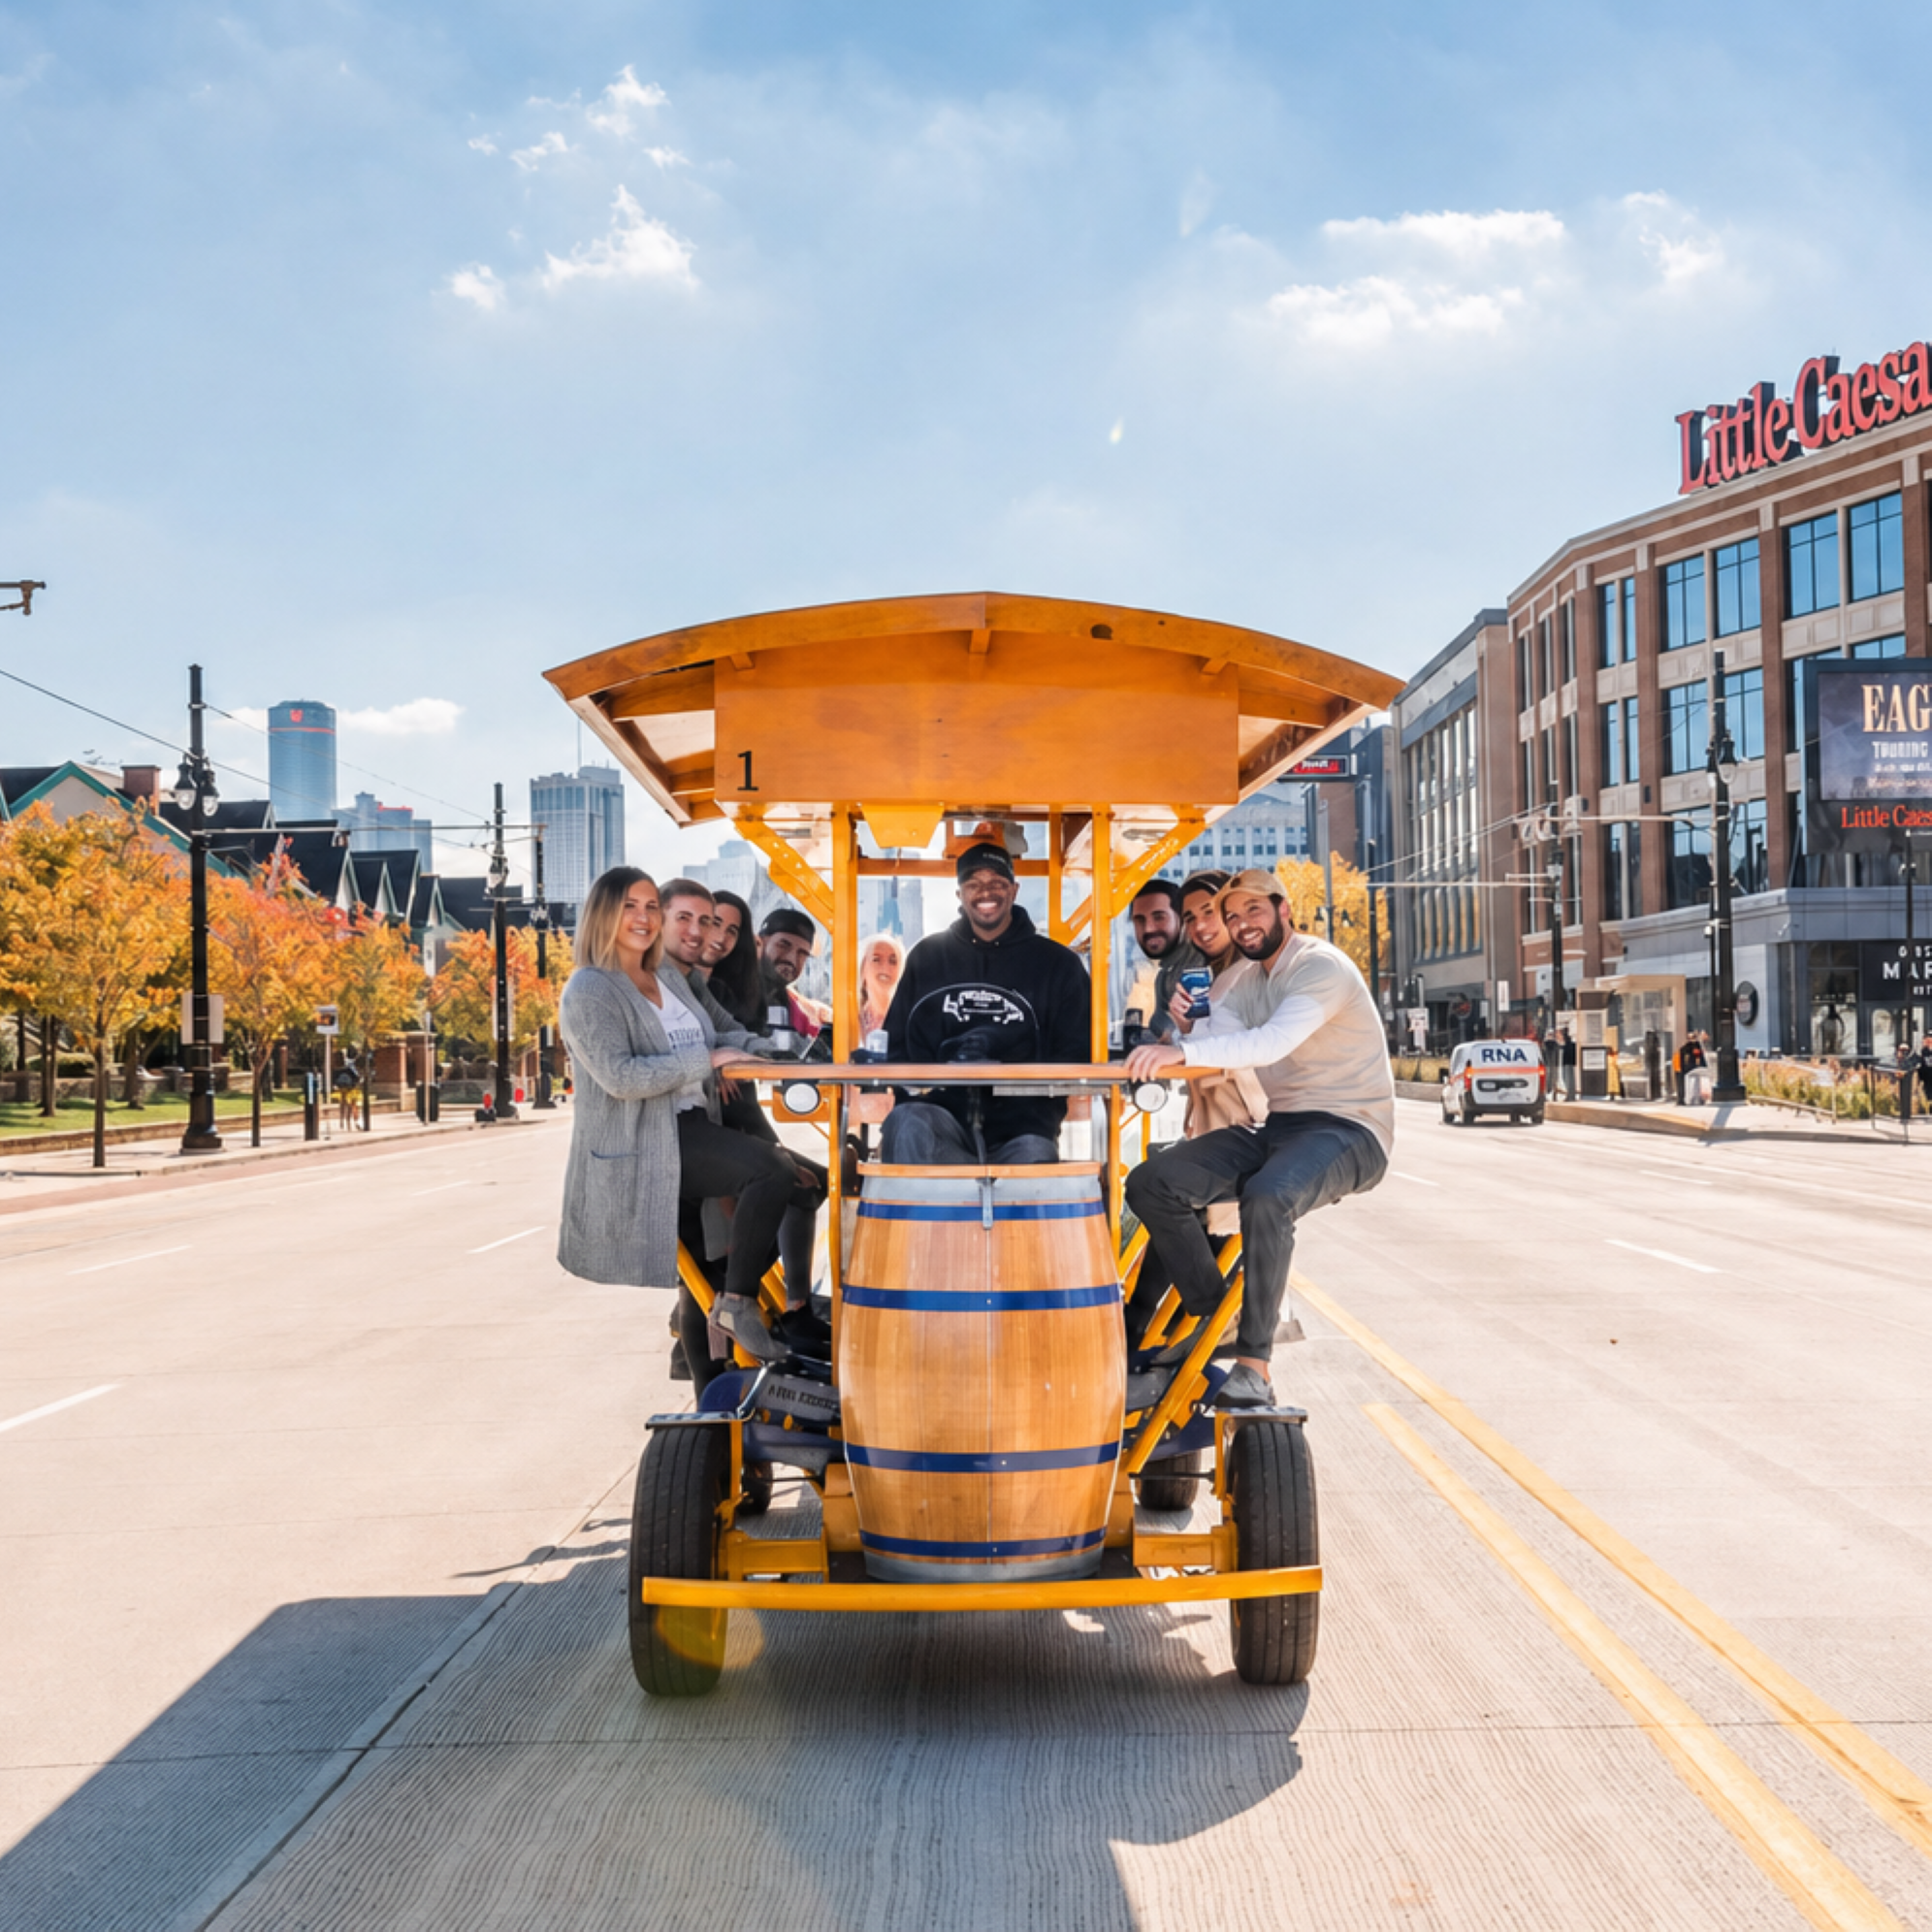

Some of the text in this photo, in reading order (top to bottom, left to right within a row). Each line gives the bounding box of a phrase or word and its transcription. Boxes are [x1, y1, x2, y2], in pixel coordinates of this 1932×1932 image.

[1676, 381, 1789, 495] Little
[737, 750, 758, 791] 1
[1841, 805, 1889, 828] Little
[1482, 1047, 1528, 1063] RNA
